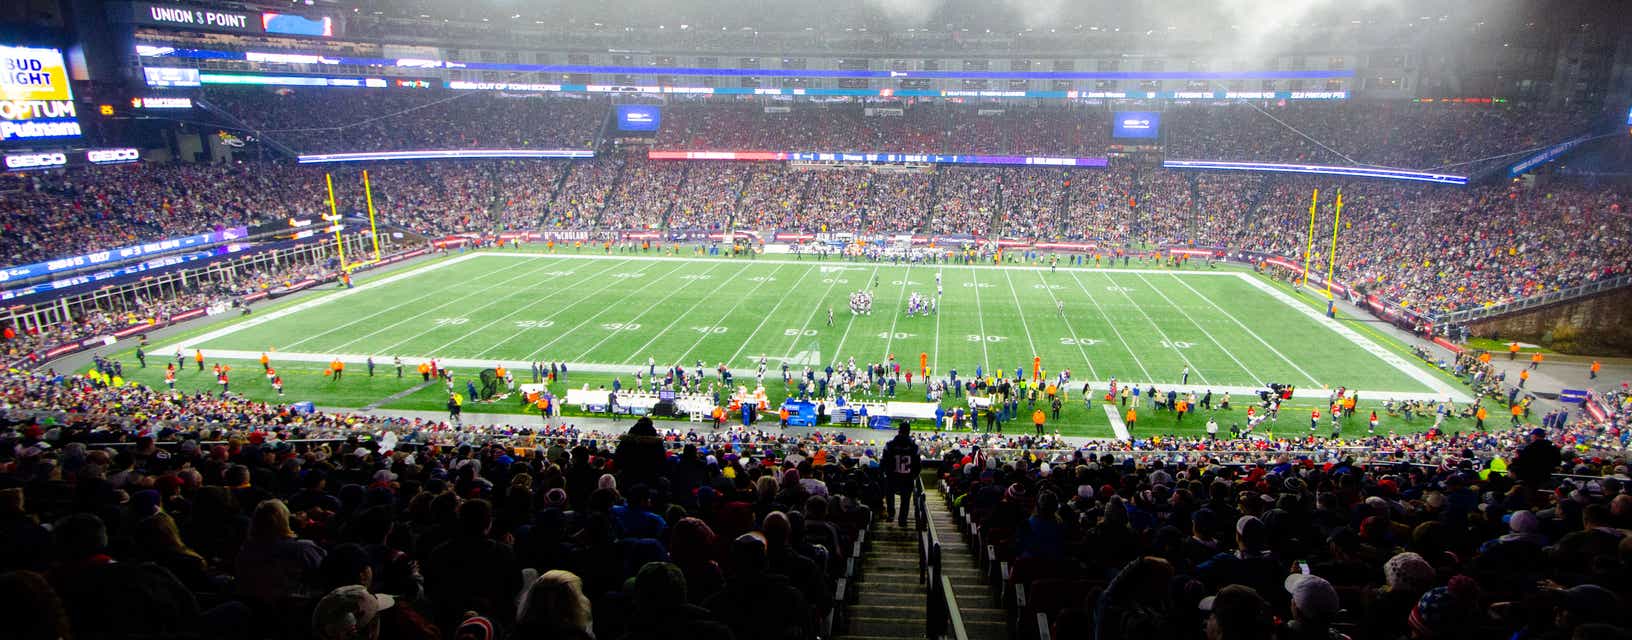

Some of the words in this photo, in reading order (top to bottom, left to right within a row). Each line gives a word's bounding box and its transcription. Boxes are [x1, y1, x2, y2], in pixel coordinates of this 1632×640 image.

[150, 7, 193, 23] UNION
[206, 12, 247, 28] POINT
[4, 72, 50, 85] IGHT
[0, 100, 76, 119] OPTUM
[2, 121, 81, 137] Putnam
[5, 153, 66, 168] GEICO
[88, 149, 138, 162] GEICO
[607, 322, 641, 331] 30
[696, 325, 728, 334] 40
[784, 328, 818, 336] 50
[877, 331, 908, 340] 40
[967, 334, 1000, 343] 30
[1060, 336, 1095, 345] 20
[1160, 340, 1191, 349] 10
[894, 455, 911, 473] 12
